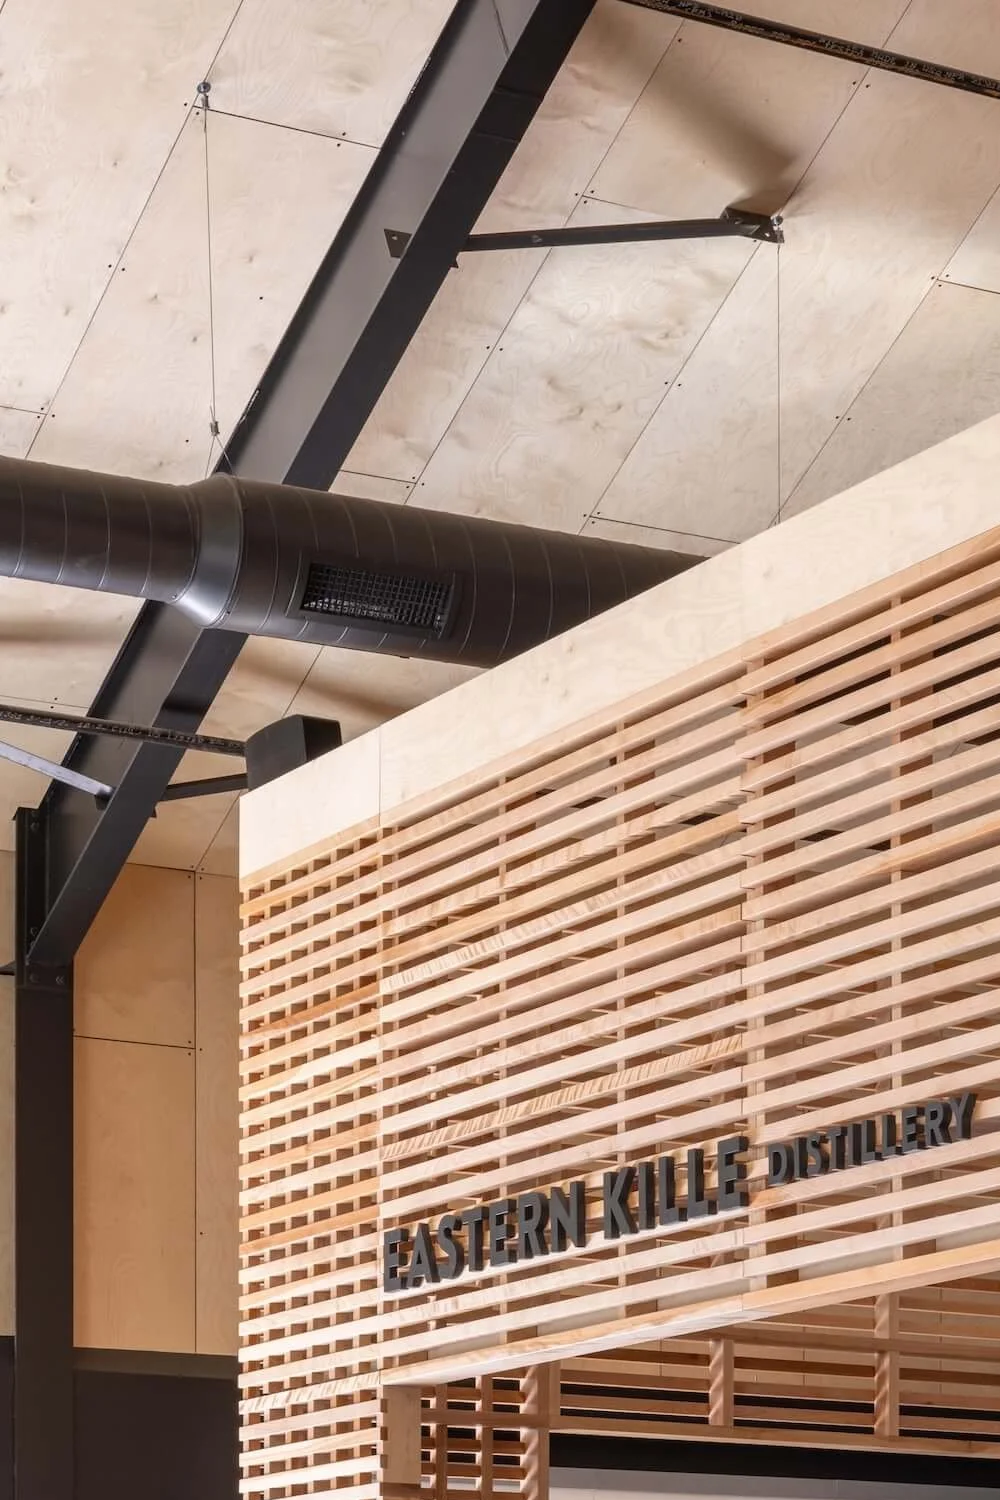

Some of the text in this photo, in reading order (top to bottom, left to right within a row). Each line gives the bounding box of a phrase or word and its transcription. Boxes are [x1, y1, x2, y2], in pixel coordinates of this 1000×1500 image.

[383, 1091, 978, 1292] EASTERN KILLE DISTILLERY
